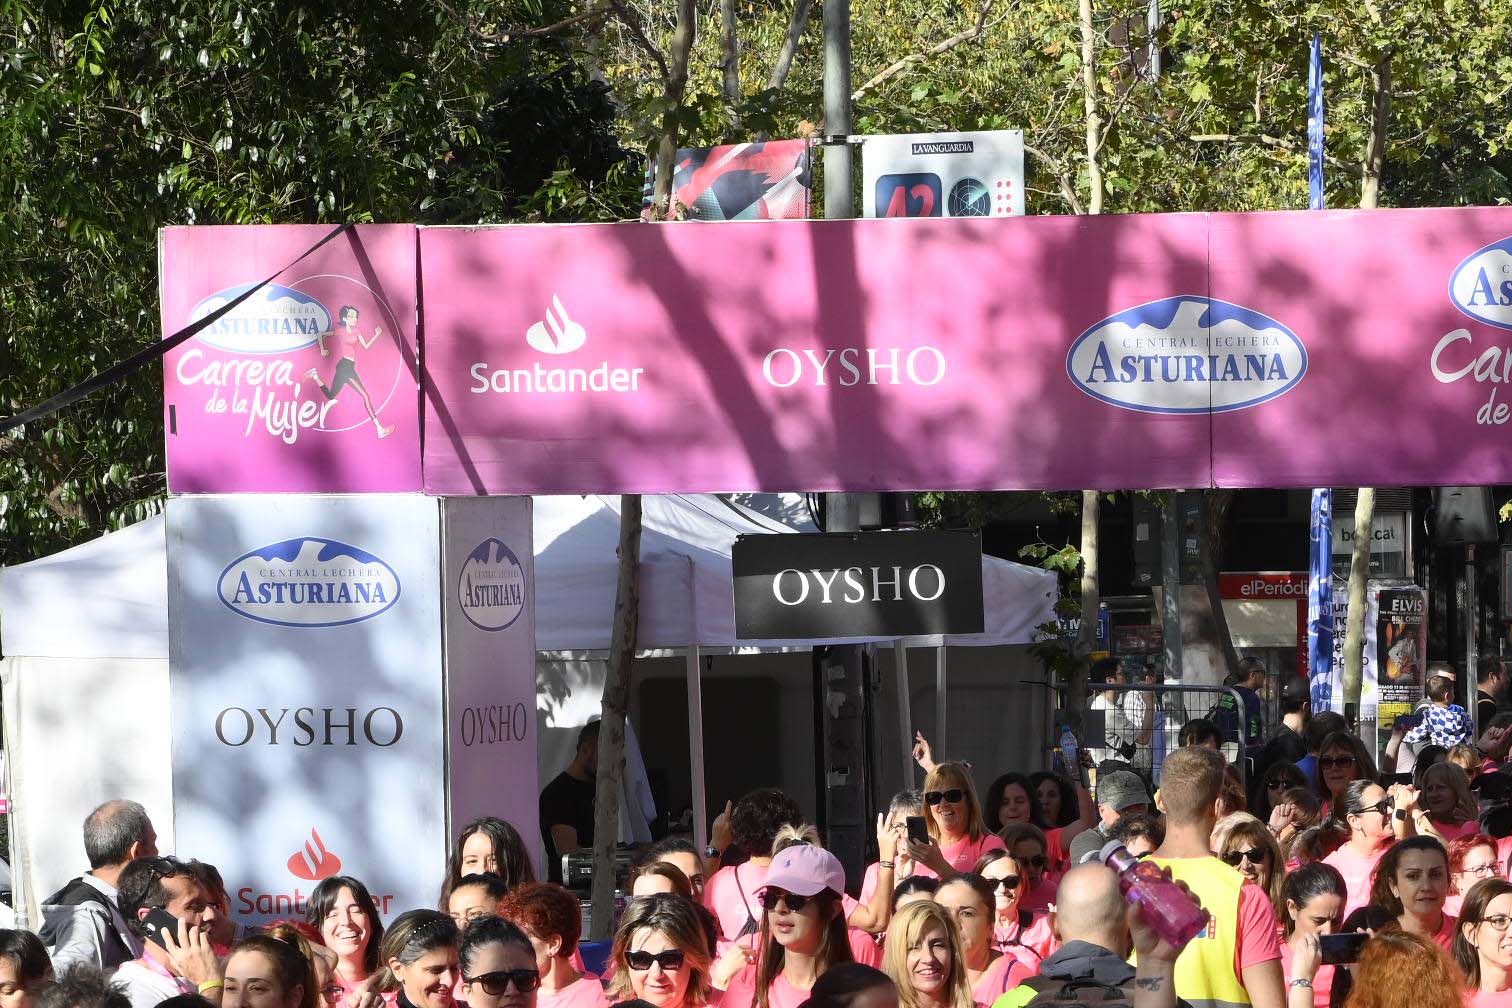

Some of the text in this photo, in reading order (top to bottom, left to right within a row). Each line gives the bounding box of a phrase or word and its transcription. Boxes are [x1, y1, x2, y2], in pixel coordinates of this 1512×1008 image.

[1123, 334, 1281, 348] CENTRAL LECHERA
[176, 348, 294, 386] Carrera
[469, 362, 644, 394] Santander
[761, 345, 946, 388] OYSHO
[1086, 340, 1289, 384] ASTURIANA
[205, 384, 338, 445] de la Mujer
[1476, 387, 1512, 426] de
[232, 571, 387, 605] ASTURIANA
[259, 567, 381, 578] CENTRAL LECHERA
[463, 573, 522, 608] ASTURIANA
[772, 563, 946, 606] OYSHO
[1392, 599, 1423, 612] ELVIS
[214, 706, 404, 748] OYSHO
[461, 702, 527, 747] OYSHO
[238, 887, 394, 916] Santer
